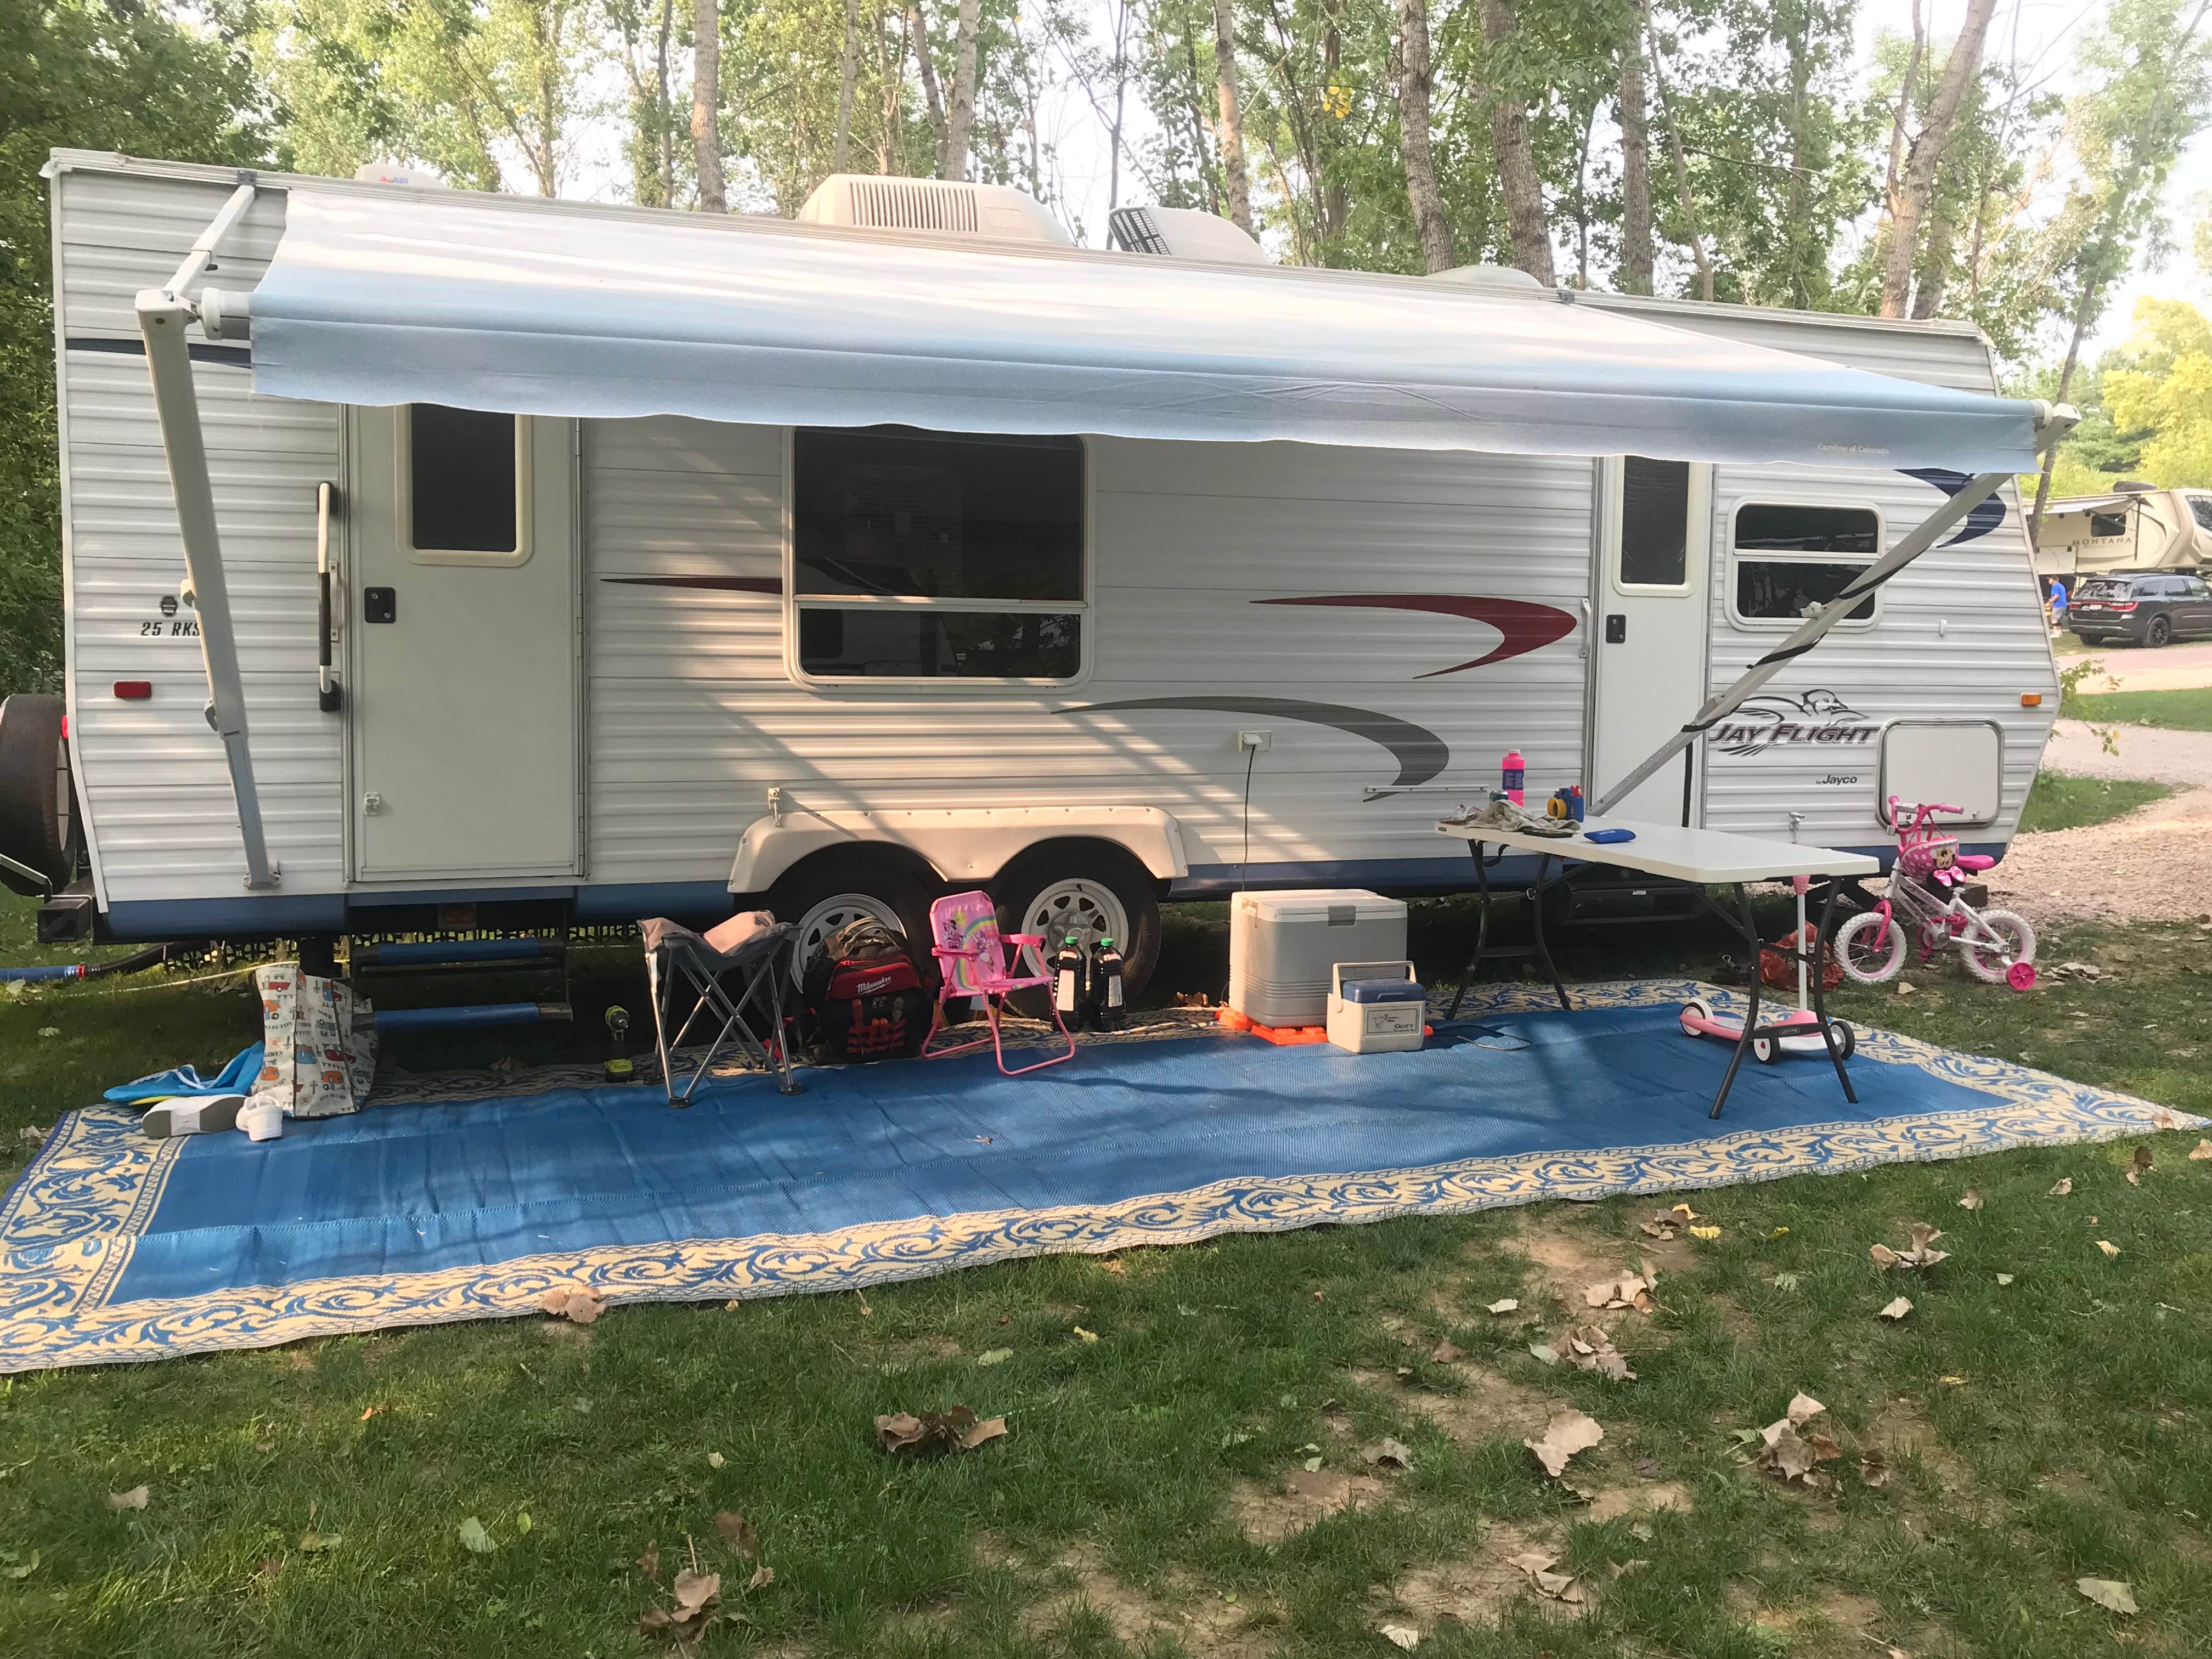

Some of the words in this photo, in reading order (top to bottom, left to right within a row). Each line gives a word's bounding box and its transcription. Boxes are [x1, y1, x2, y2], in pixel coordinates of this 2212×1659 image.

[1818, 443, 1848, 452] Carefree
[1858, 445, 1891, 454] Colorado
[2072, 538, 2132, 546] MONTANA
[140, 622, 162, 636] 25
[1707, 723, 1771, 744] JAY
[1768, 723, 1881, 744] FLIGHT
[1822, 775, 1858, 786] Jayco
[856, 976, 891, 994] Milwaukee
